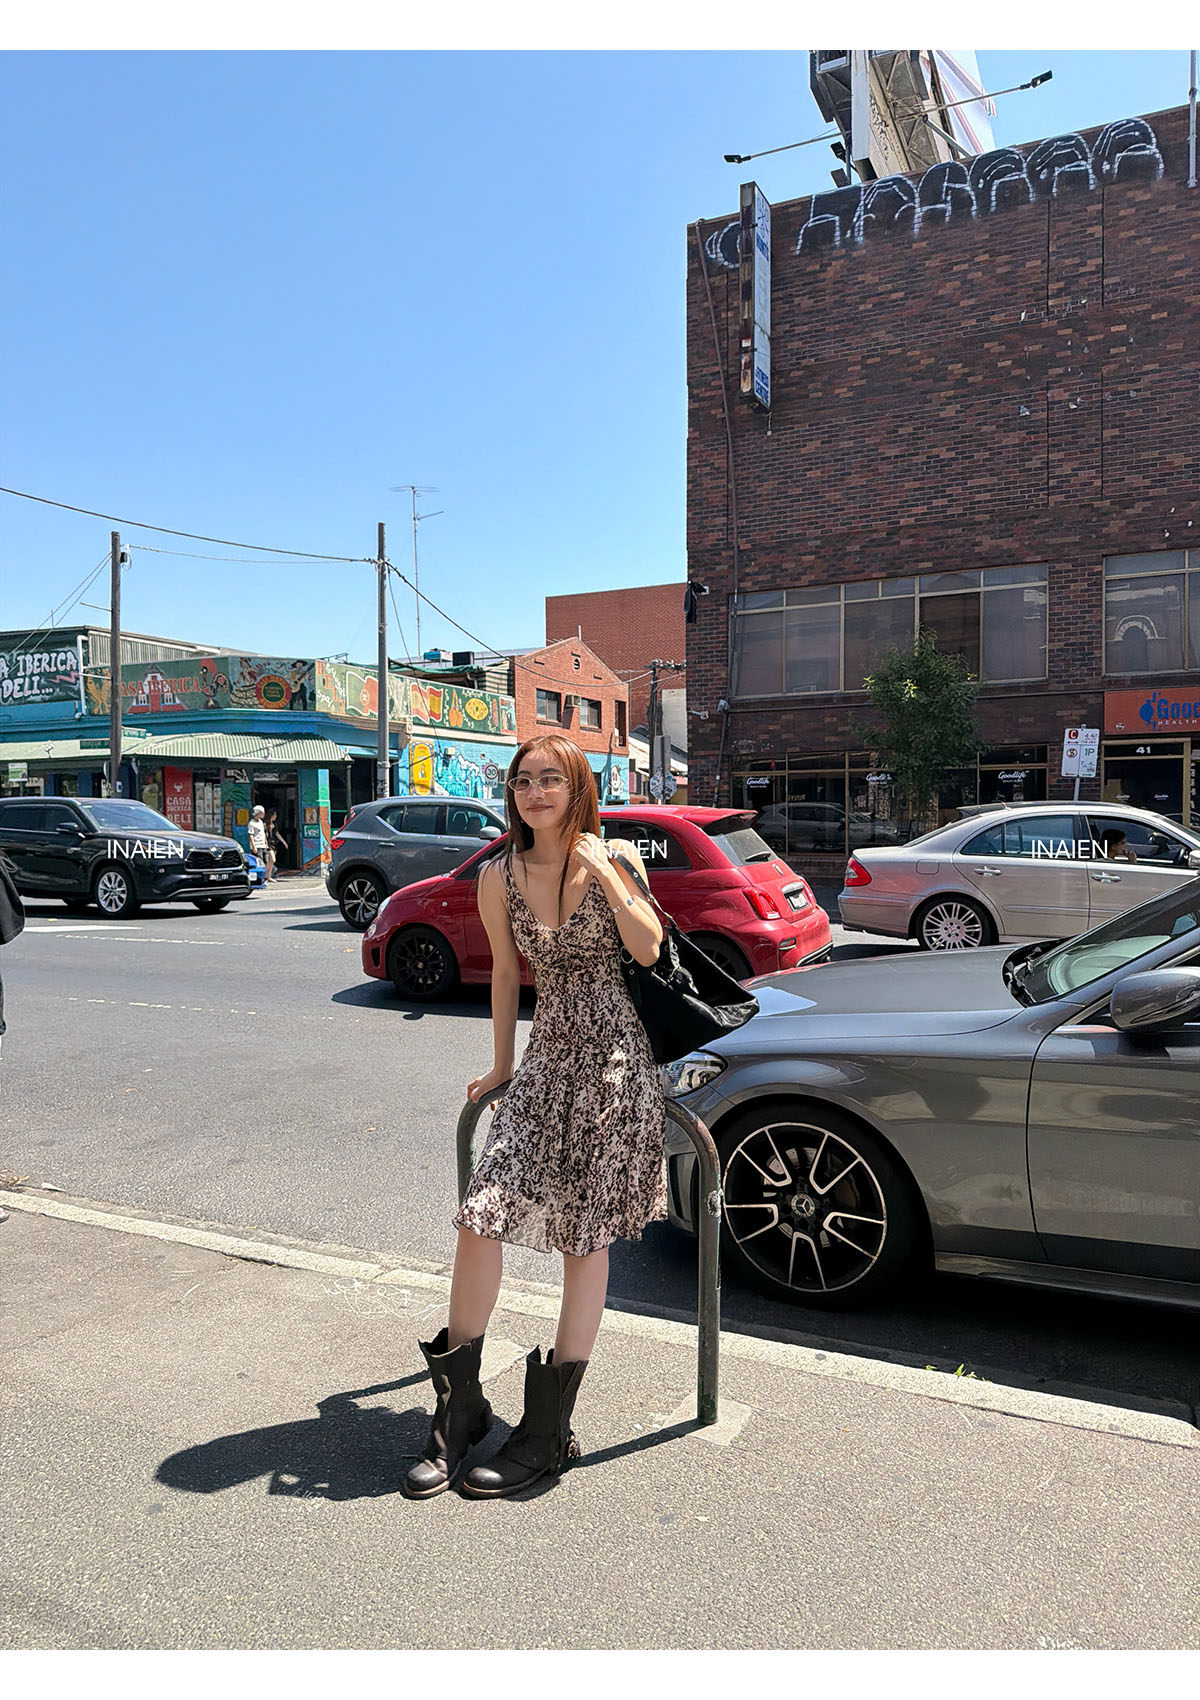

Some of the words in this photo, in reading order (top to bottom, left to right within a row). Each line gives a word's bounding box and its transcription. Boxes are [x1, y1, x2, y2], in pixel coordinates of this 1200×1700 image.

[17, 651, 78, 676] IBERICA
[2, 676, 53, 698] DELI...
[120, 681, 145, 696] ASA
[148, 676, 201, 693] IBERICA
[1136, 746, 1151, 754] 41
[487, 768, 496, 776] 30
[166, 797, 191, 805] CASA
[167, 814, 191, 823] DELI
